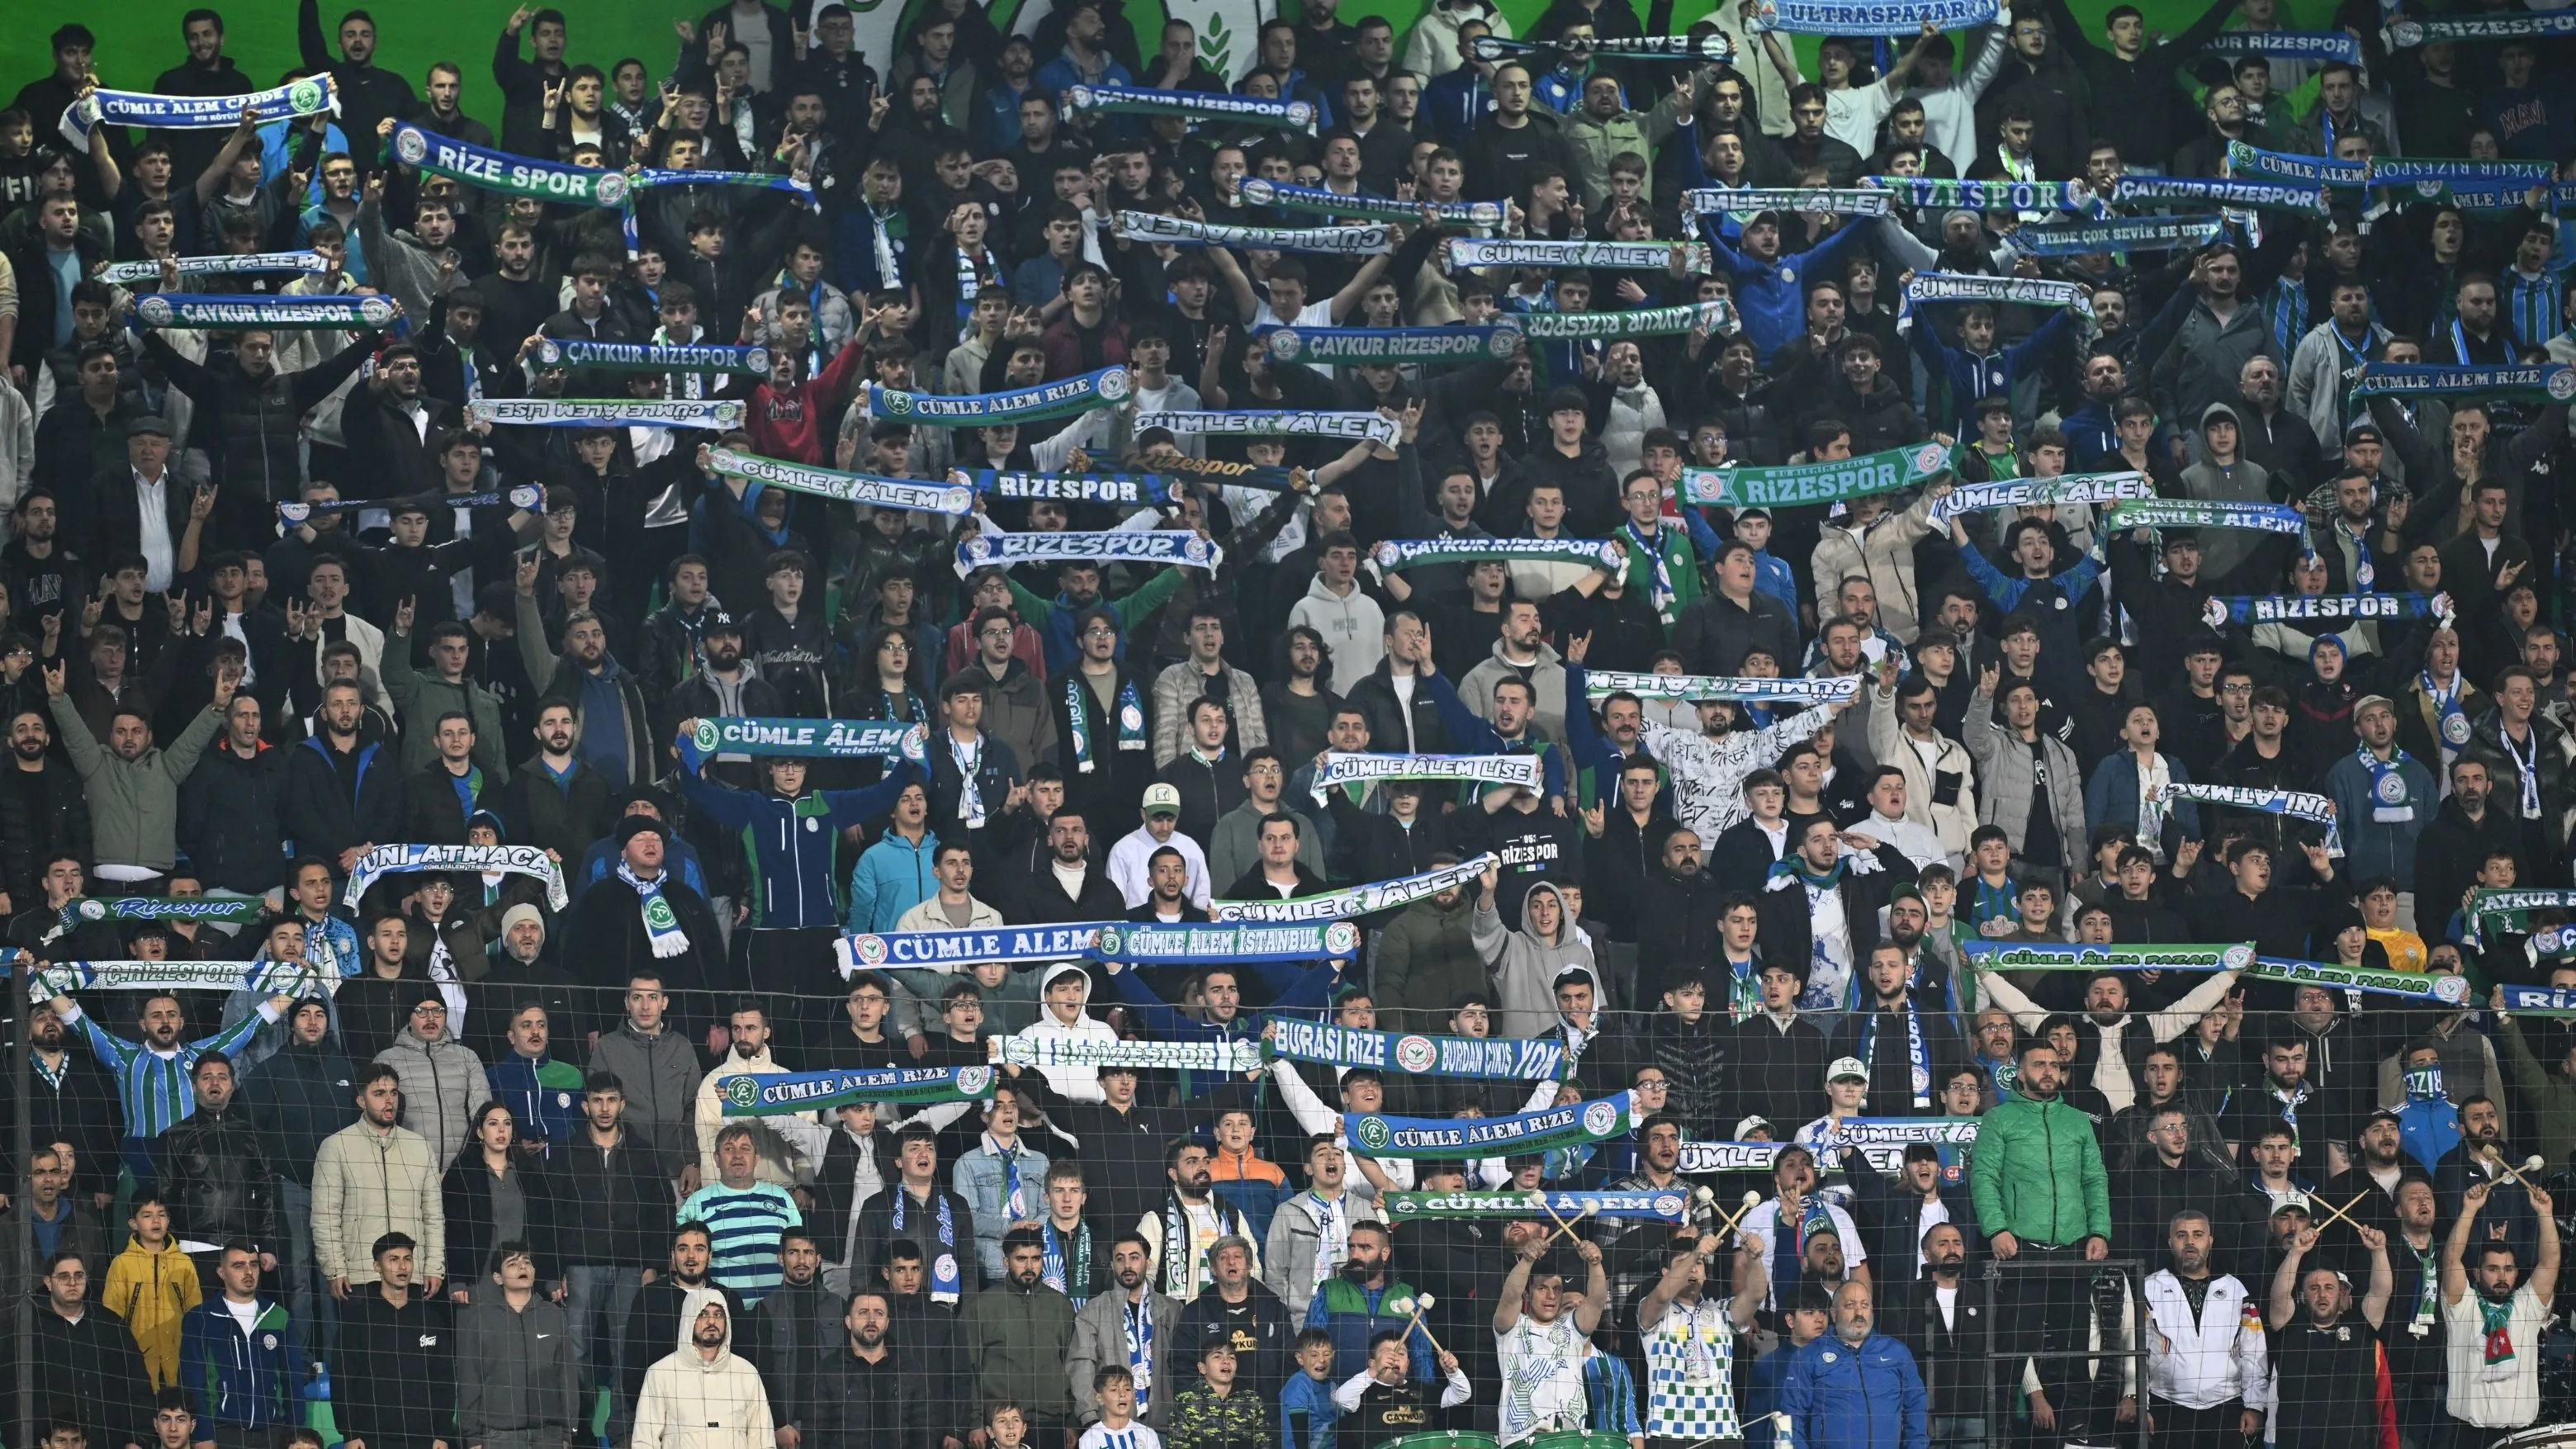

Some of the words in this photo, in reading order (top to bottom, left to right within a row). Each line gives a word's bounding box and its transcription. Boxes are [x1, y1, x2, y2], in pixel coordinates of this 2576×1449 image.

[1788, 1, 1968, 23] ULTRASPAZAR
[2429, 16, 2576, 38] RİZESPO
[2248, 33, 2351, 53] RİZESPOR
[107, 99, 165, 115] CÜMLE
[172, 98, 220, 114] ÂLEM
[1094, 90, 1174, 107] ÇAYKUR
[1181, 94, 1285, 117] RİZESPOR
[436, 145, 504, 183] RİZE
[511, 165, 589, 197] SPOR
[2260, 154, 2315, 178] CÜMLE
[2320, 163, 2365, 182] ÂLEM
[2481, 163, 2550, 179] AYKUR
[1277, 189, 1360, 211] ÇAYKUR
[2120, 181, 2206, 199] ÇAYKUR
[2209, 182, 2314, 208] RİZESPOR
[2452, 192, 2496, 209] MLE
[1126, 212, 1232, 245] ÂLEM
[2037, 228, 2078, 245] BİZDE
[2082, 228, 2109, 244] ÇOK
[2113, 225, 2156, 240] SEVİK
[2159, 226, 2178, 239] BE
[1272, 230, 1385, 253] CÜMLE
[118, 260, 207, 280] CÜLE
[236, 253, 323, 271] ÂLEM
[1478, 242, 1563, 263] CÜMLE
[1590, 242, 1672, 268] ÂLEM
[1909, 274, 1987, 297] CÜMLE
[2017, 278, 2094, 313] ÂLEM
[181, 302, 259, 324] ÇAYKUR
[261, 299, 354, 323] RİZESPOR
[1626, 306, 1694, 333] ÇAYKUR
[1528, 315, 1621, 337] RİZESPOR
[567, 342, 642, 365] ÇAYKUR
[650, 343, 739, 367] RİZESPOR
[1309, 337, 1385, 358] ÇAYKUR
[1388, 333, 1480, 355] RİZESPOR
[2365, 374, 2430, 391] CÜMLE
[2436, 371, 2490, 387] ÂLEM
[497, 402, 547, 418] LİSE
[554, 403, 622, 423] ÂLEM
[626, 403, 706, 421] CÜMLE
[916, 395, 983, 414] CÜMLE
[988, 391, 1043, 413] ÂLEM
[1288, 414, 1395, 443] ÂLEM
[742, 461, 829, 491] CÜMLE
[856, 479, 940, 509] ÂLEM
[999, 474, 1137, 501] RİZESPOR
[1746, 463, 1897, 503] RİZESPOR
[1946, 485, 2031, 511] ÜMLE
[2145, 500, 2174, 509] HER
[2117, 509, 2214, 527] CÜMLE
[1400, 538, 1489, 561] ÇAYKUR
[1489, 537, 1600, 557] RİZESPOR
[2255, 596, 2398, 620] RİZESPOR
[1736, 674, 1860, 700] CÜMLE
[724, 721, 815, 746] CÜMLE
[823, 722, 903, 746] ÂLEM
[830, 745, 890, 754] TRİBÜN
[1331, 757, 1405, 779] CÜMLE
[1411, 757, 1475, 776] ÂLEM
[1480, 759, 1532, 781] LİSE
[2166, 783, 2276, 807] ATMAC
[2284, 793, 2329, 822] ÜNİ
[362, 843, 410, 874] ÜNİ
[420, 845, 552, 874] ATMACA
[424, 862, 447, 870] CÜMLE
[466, 862, 491, 870] TRİBÜN
[1501, 843, 1559, 865] RİZESPOR
[1219, 899, 1337, 922] CÜMLE
[1380, 862, 1488, 907] ÂLEM
[111, 898, 246, 920] Rizespor
[893, 934, 1001, 960] CÜMLE
[1012, 929, 1096, 954] ALEM
[1129, 926, 1186, 955] CÜMLE
[1187, 927, 1236, 954] ÂLEM
[1237, 924, 1322, 954] İSTANBUL
[2001, 949, 2075, 966] CÜMLE
[2079, 949, 2140, 965] ÂLEM
[2145, 953, 2218, 966] PAZAR
[106, 962, 237, 985] Ç.RİZESPOR
[2290, 960, 2352, 983] ÂLEM
[2356, 975, 2431, 994] PAZAR
[1054, 1040, 1216, 1065] Ç.RİZESPOR
[1275, 1019, 1342, 1061] BURASI
[1346, 1030, 1385, 1065] RİZE
[1442, 1039, 1483, 1073] BURDAN
[1512, 1039, 1562, 1079] YOK
[763, 1077, 834, 1105] CÜMLE
[840, 1068, 897, 1088] ÂLEM
[1394, 1129, 1463, 1147] CÜMLE
[1467, 1123, 1525, 1141] ÂLEM
[1835, 1123, 1924, 1144] CÜMLE
[1679, 1141, 1772, 1170] ÜMLE
[1235, 1339, 1259, 1348] YKUR
